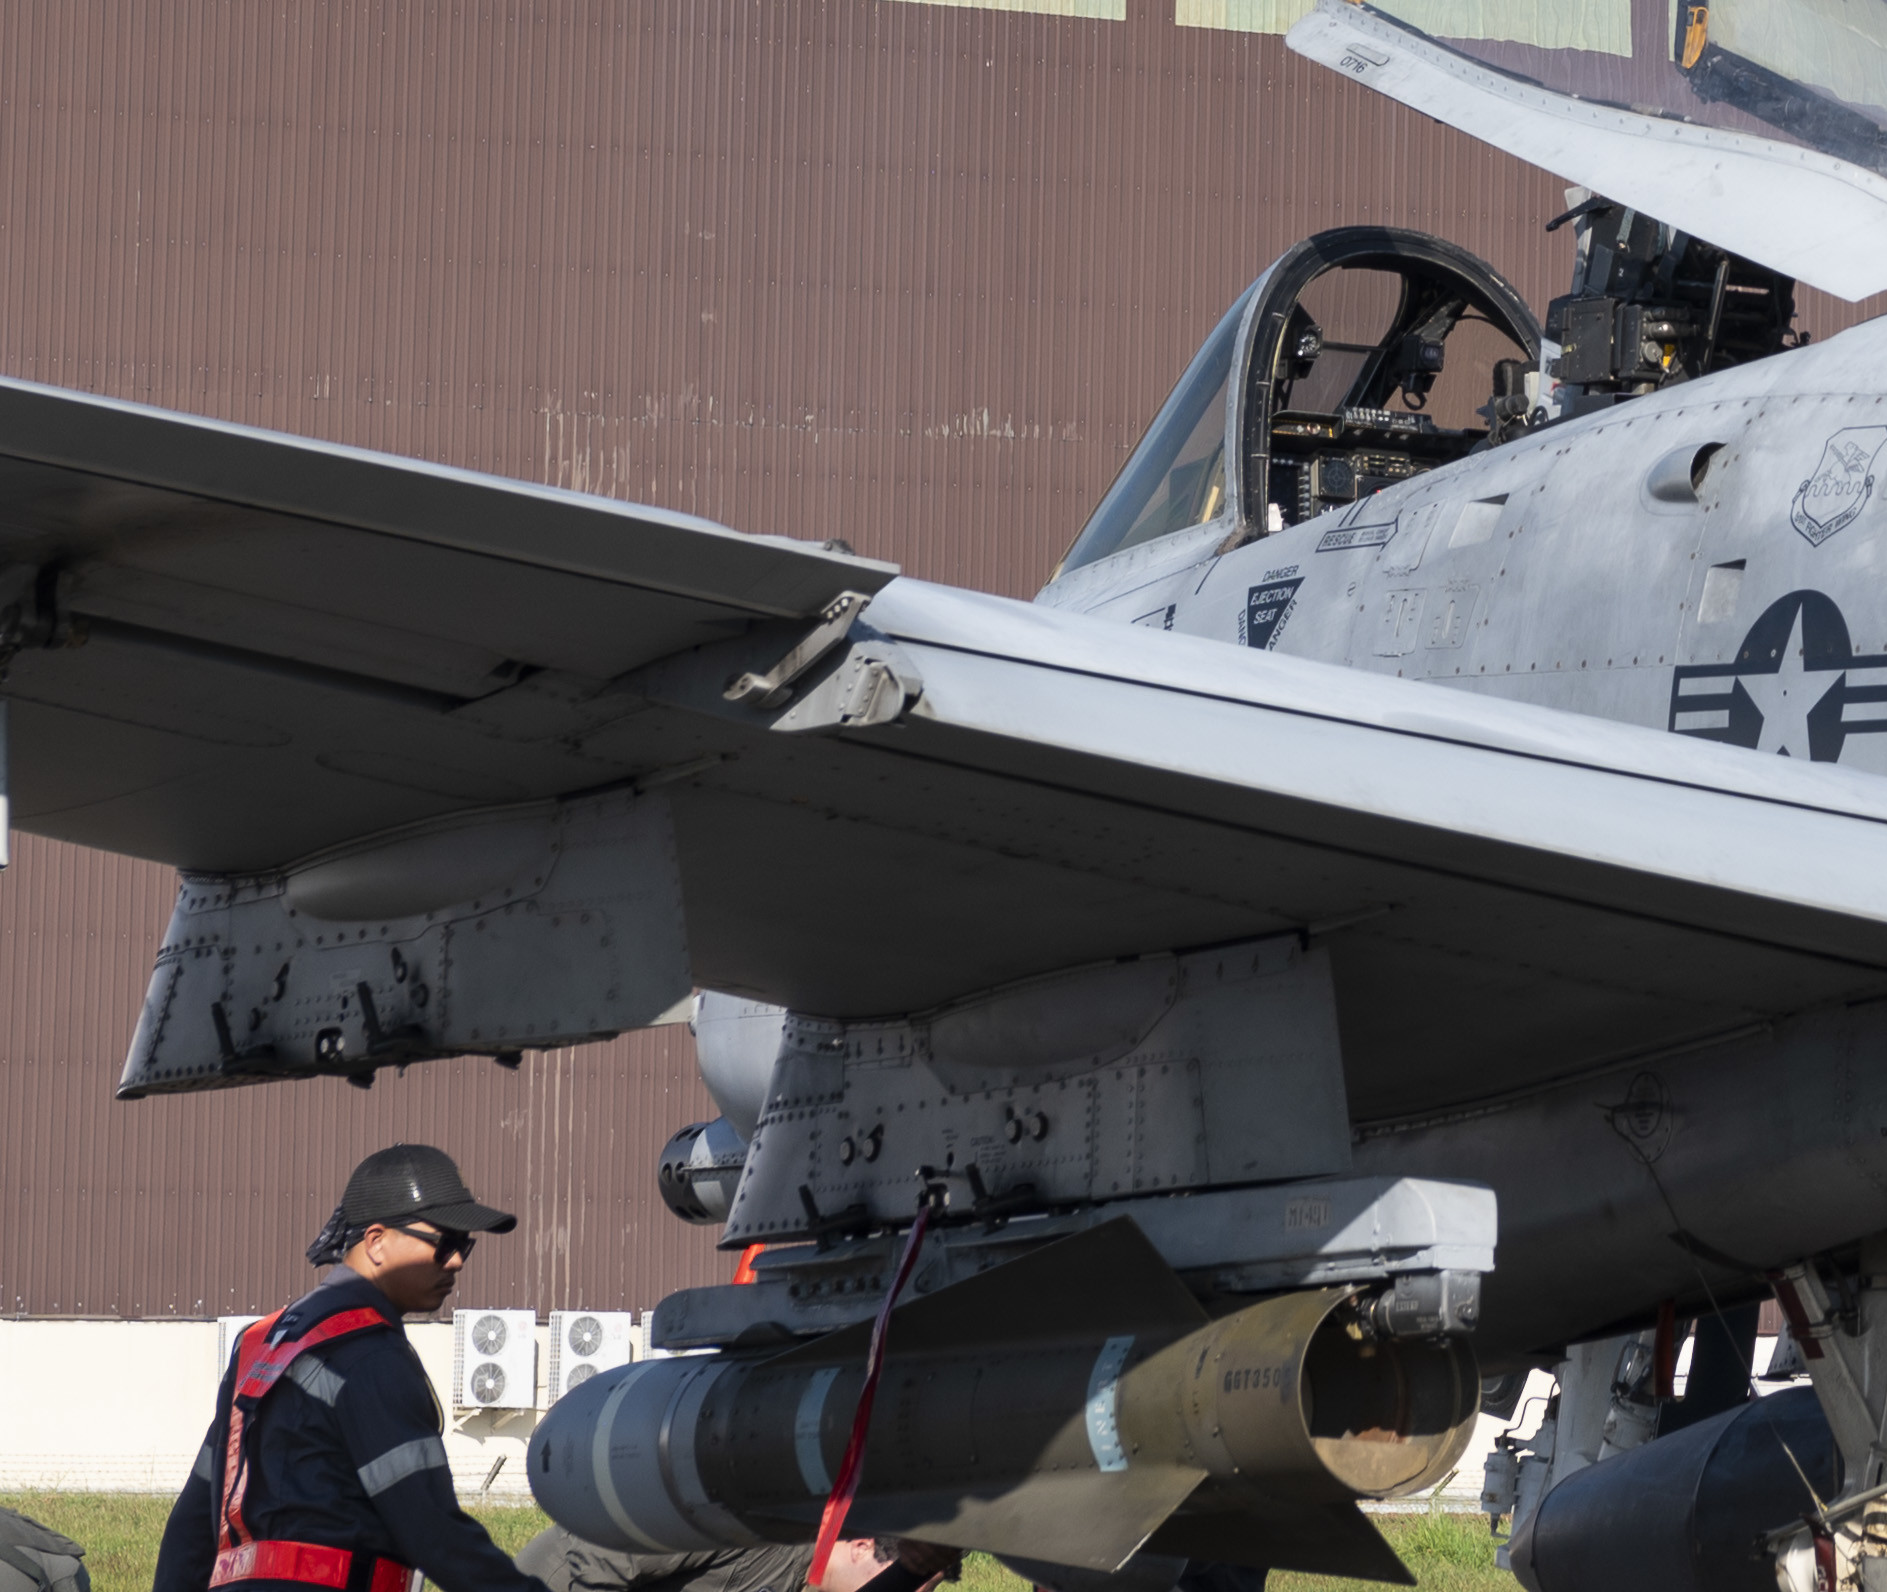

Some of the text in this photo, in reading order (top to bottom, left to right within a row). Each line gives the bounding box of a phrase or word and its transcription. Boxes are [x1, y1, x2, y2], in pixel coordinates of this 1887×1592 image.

[1321, 532, 1356, 547] RESCUE
[1262, 565, 1299, 583] DANGER
[1250, 585, 1296, 607] EJECTION
[1252, 608, 1278, 625] SEAT
[1269, 598, 1298, 651] ANGER
